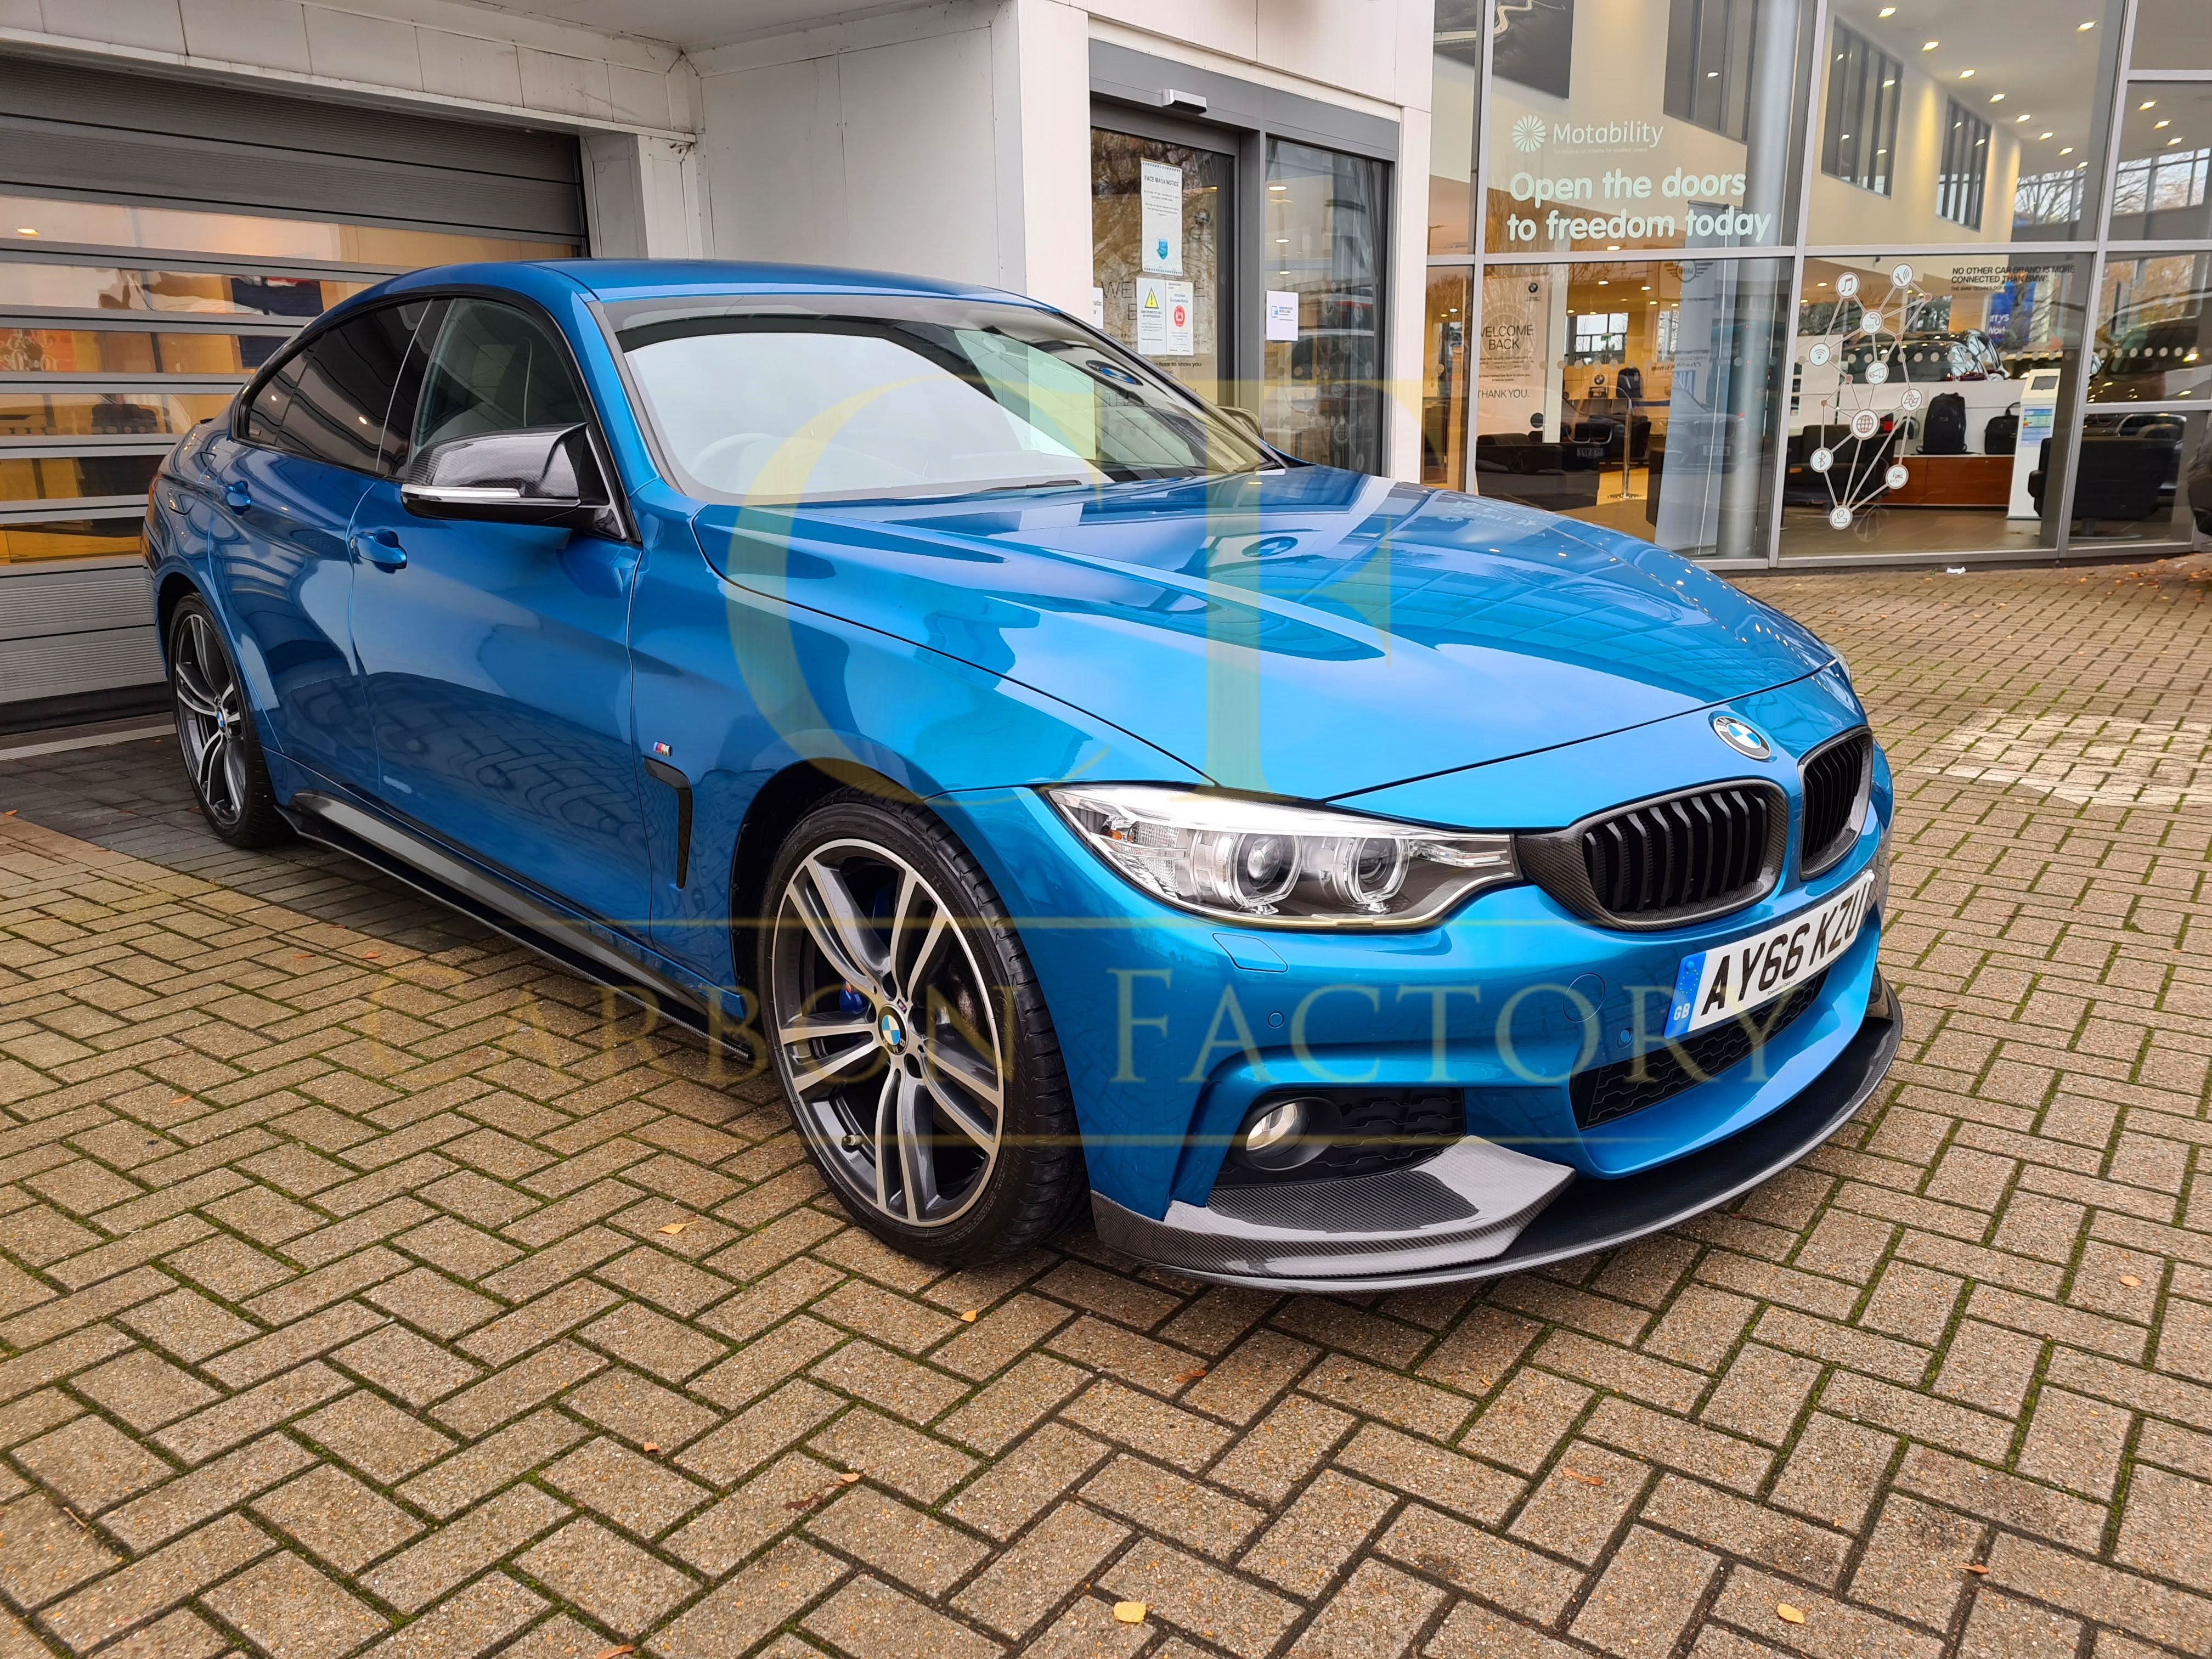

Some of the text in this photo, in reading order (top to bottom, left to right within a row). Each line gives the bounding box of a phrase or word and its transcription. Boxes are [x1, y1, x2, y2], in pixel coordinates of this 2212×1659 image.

[1553, 120, 1664, 148] Motability
[1509, 166, 1746, 208] Open the doors
[1507, 205, 1771, 243] to freedom today
[2013, 266, 2041, 274] BRAND
[2052, 264, 2076, 273] MORE
[1951, 275, 2000, 284] CONNECTED
[1489, 338, 1520, 350] BACK
[1477, 389, 1507, 399] THANK
[1700, 882, 1867, 1017] AY66 KZU
[1674, 1003, 1690, 1020] GB
